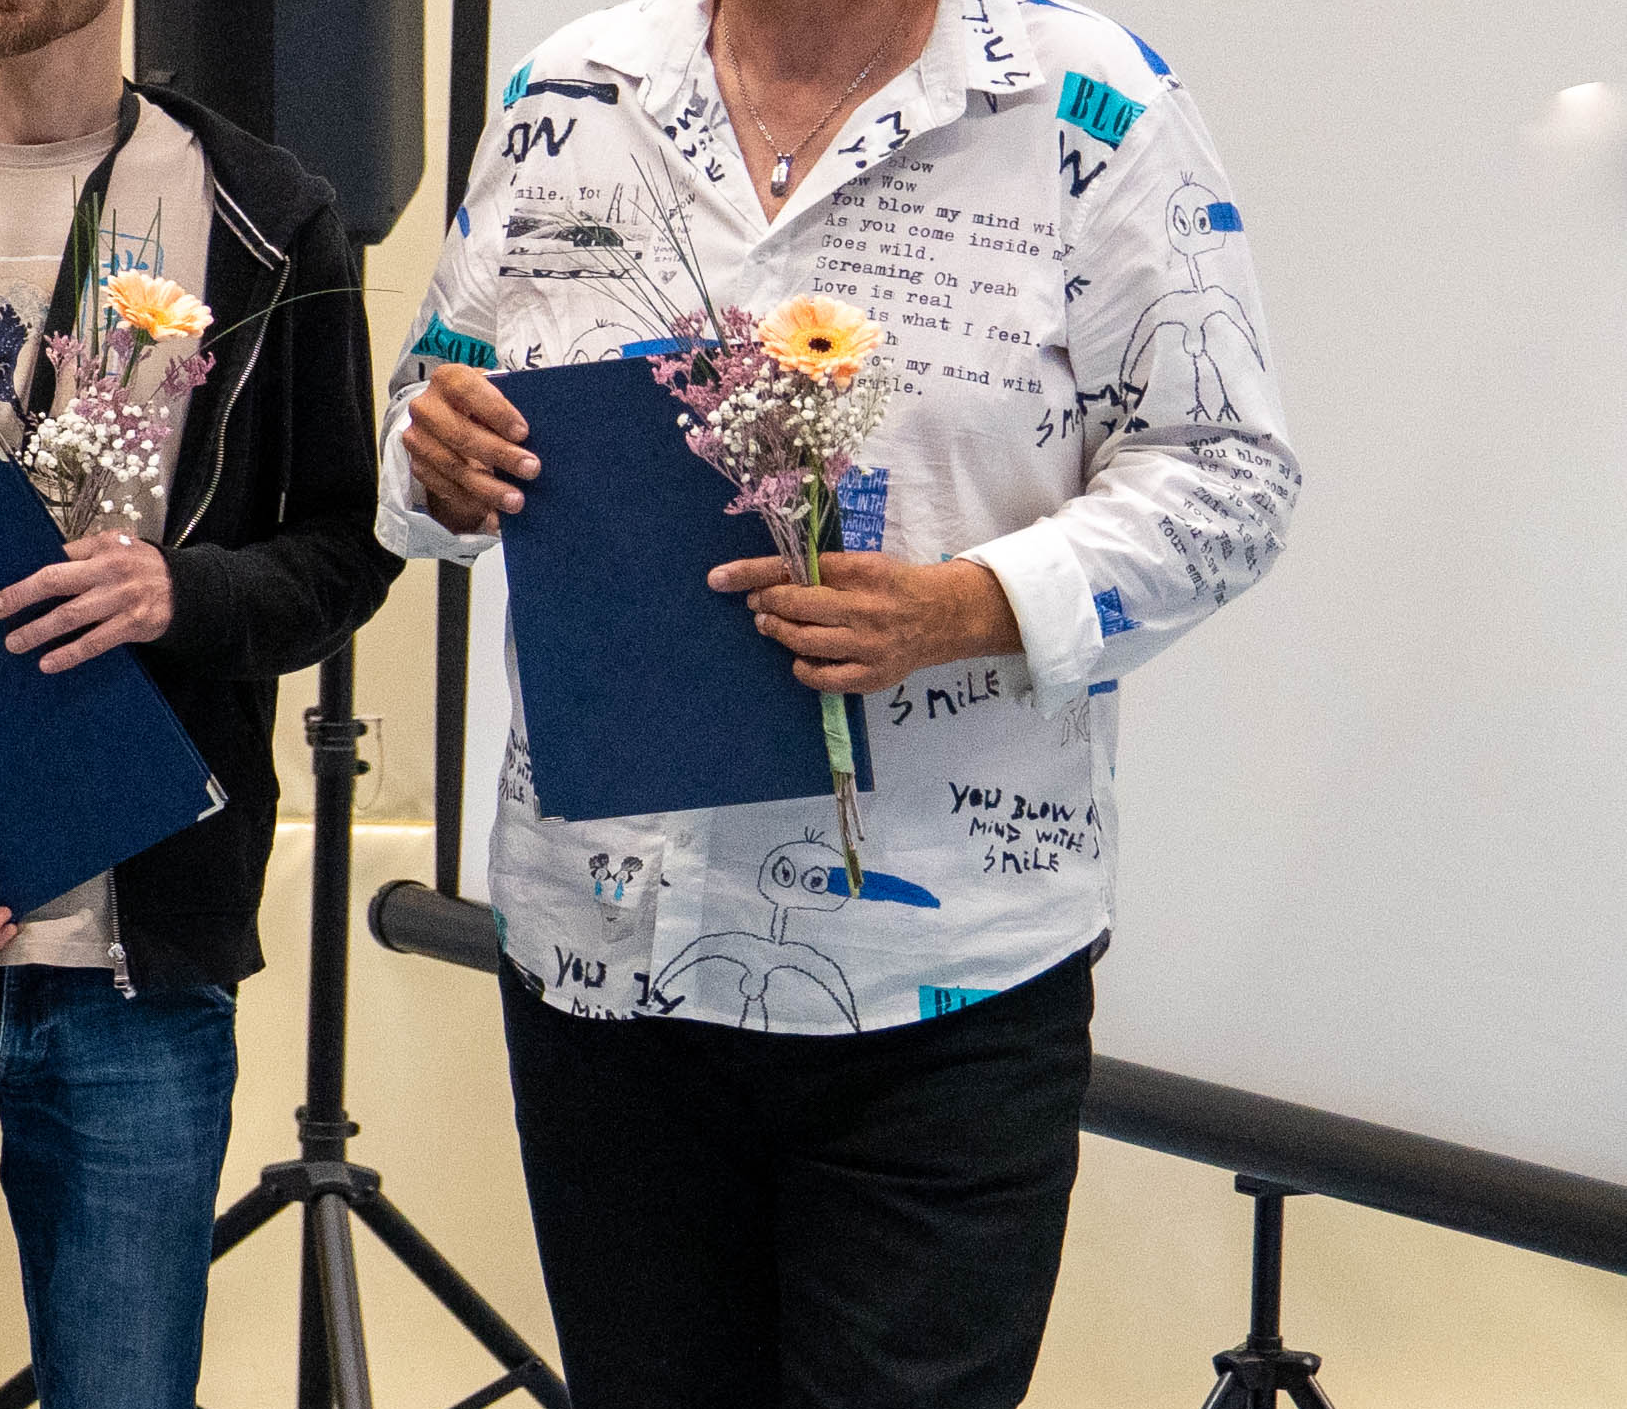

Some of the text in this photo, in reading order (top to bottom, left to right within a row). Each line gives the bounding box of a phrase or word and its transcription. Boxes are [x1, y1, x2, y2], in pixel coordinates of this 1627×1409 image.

[880, 174, 918, 193] Wow
[831, 192, 866, 209] You
[877, 196, 926, 216] blow
[935, 204, 962, 223] my
[972, 209, 1021, 232] mind
[820, 233, 936, 264] Goes wild.
[824, 212, 848, 228] As
[858, 216, 896, 234] you
[908, 224, 955, 243] come
[969, 231, 1041, 258] inside
[812, 277, 953, 310] Love is real
[816, 255, 1019, 299] Screaming Oh yeah
[866, 307, 1042, 349] is what I feel.
[905, 359, 932, 376] my
[942, 364, 991, 386] mind
[948, 781, 1002, 815] YOU
[554, 944, 608, 990] YOU
